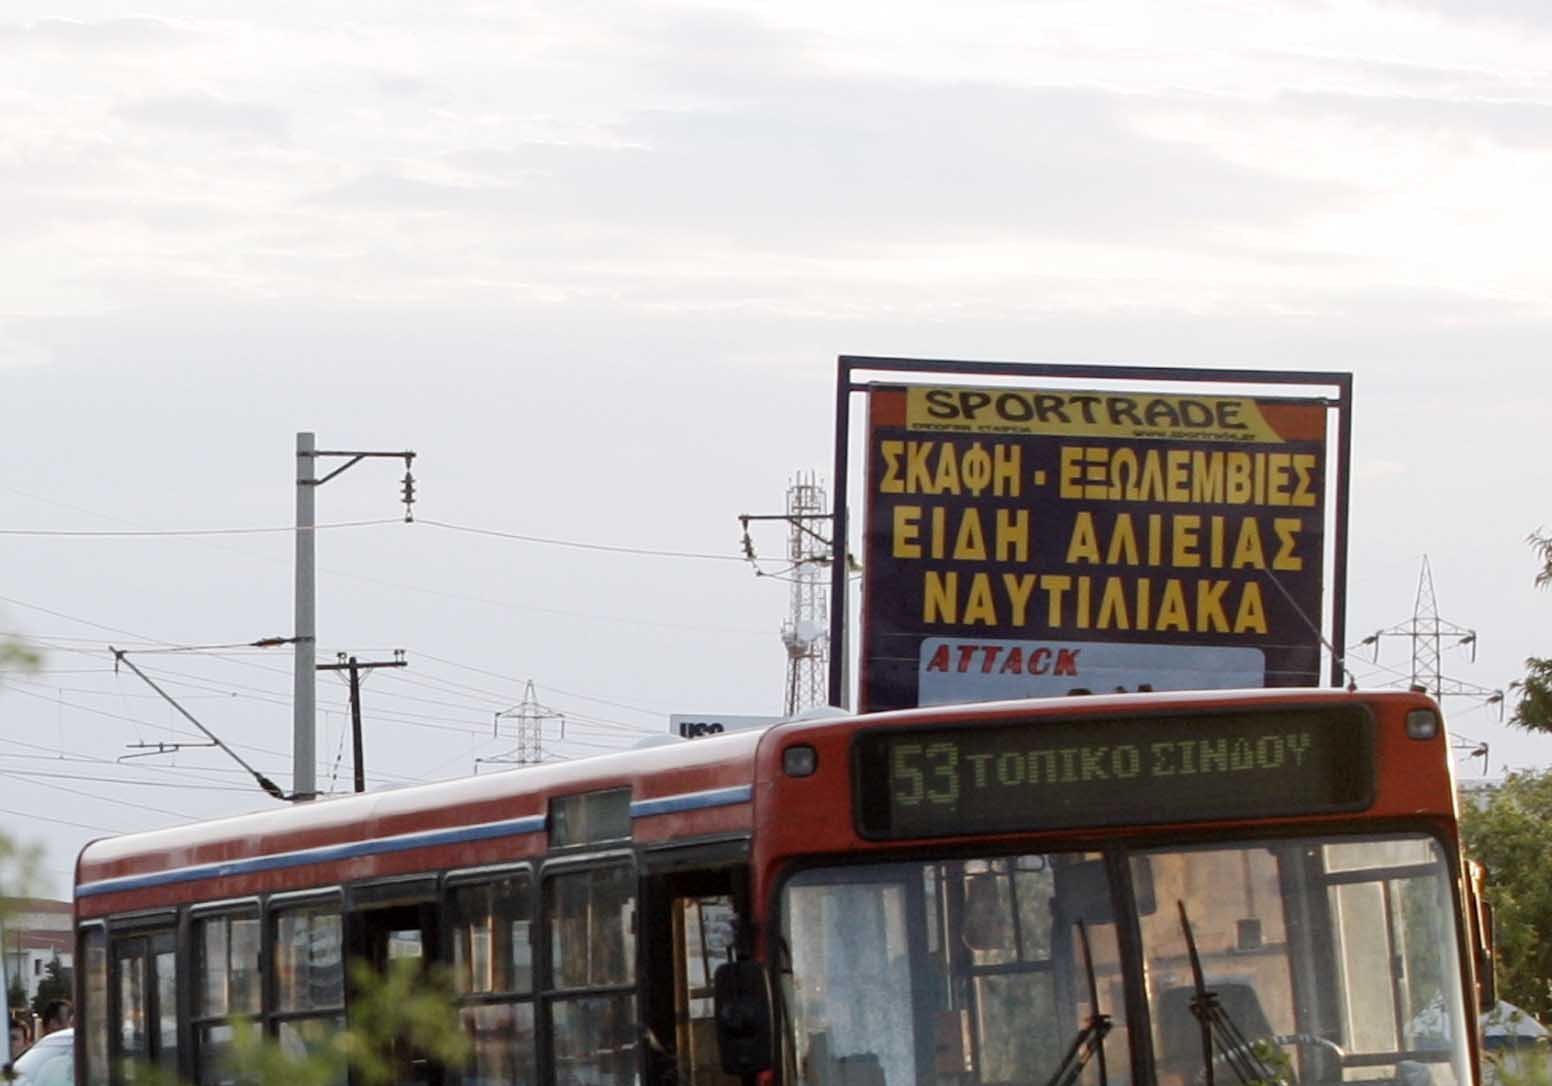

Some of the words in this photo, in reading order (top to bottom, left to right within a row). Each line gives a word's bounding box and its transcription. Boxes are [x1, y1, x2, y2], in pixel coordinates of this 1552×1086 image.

[925, 389, 1248, 430] SPORTRADE
[880, 440, 1022, 497] ΣΚΑΦΗ
[1060, 446, 1317, 507] ΕΞΩΛΕΜΒΙΕΣ
[892, 505, 1030, 562] ΕΙΔΗ
[1065, 511, 1304, 571] ΑΛΙΕΙΑΣ
[922, 570, 1268, 634] ΝΑΥΤΙΛΙΑΚΑ
[926, 644, 1081, 677] ATTACK
[895, 742, 960, 805] 53
[964, 744, 1140, 788] ΤΟΠΙΚΟ
[1151, 733, 1313, 776] ΣΙΝΔΟΥ
